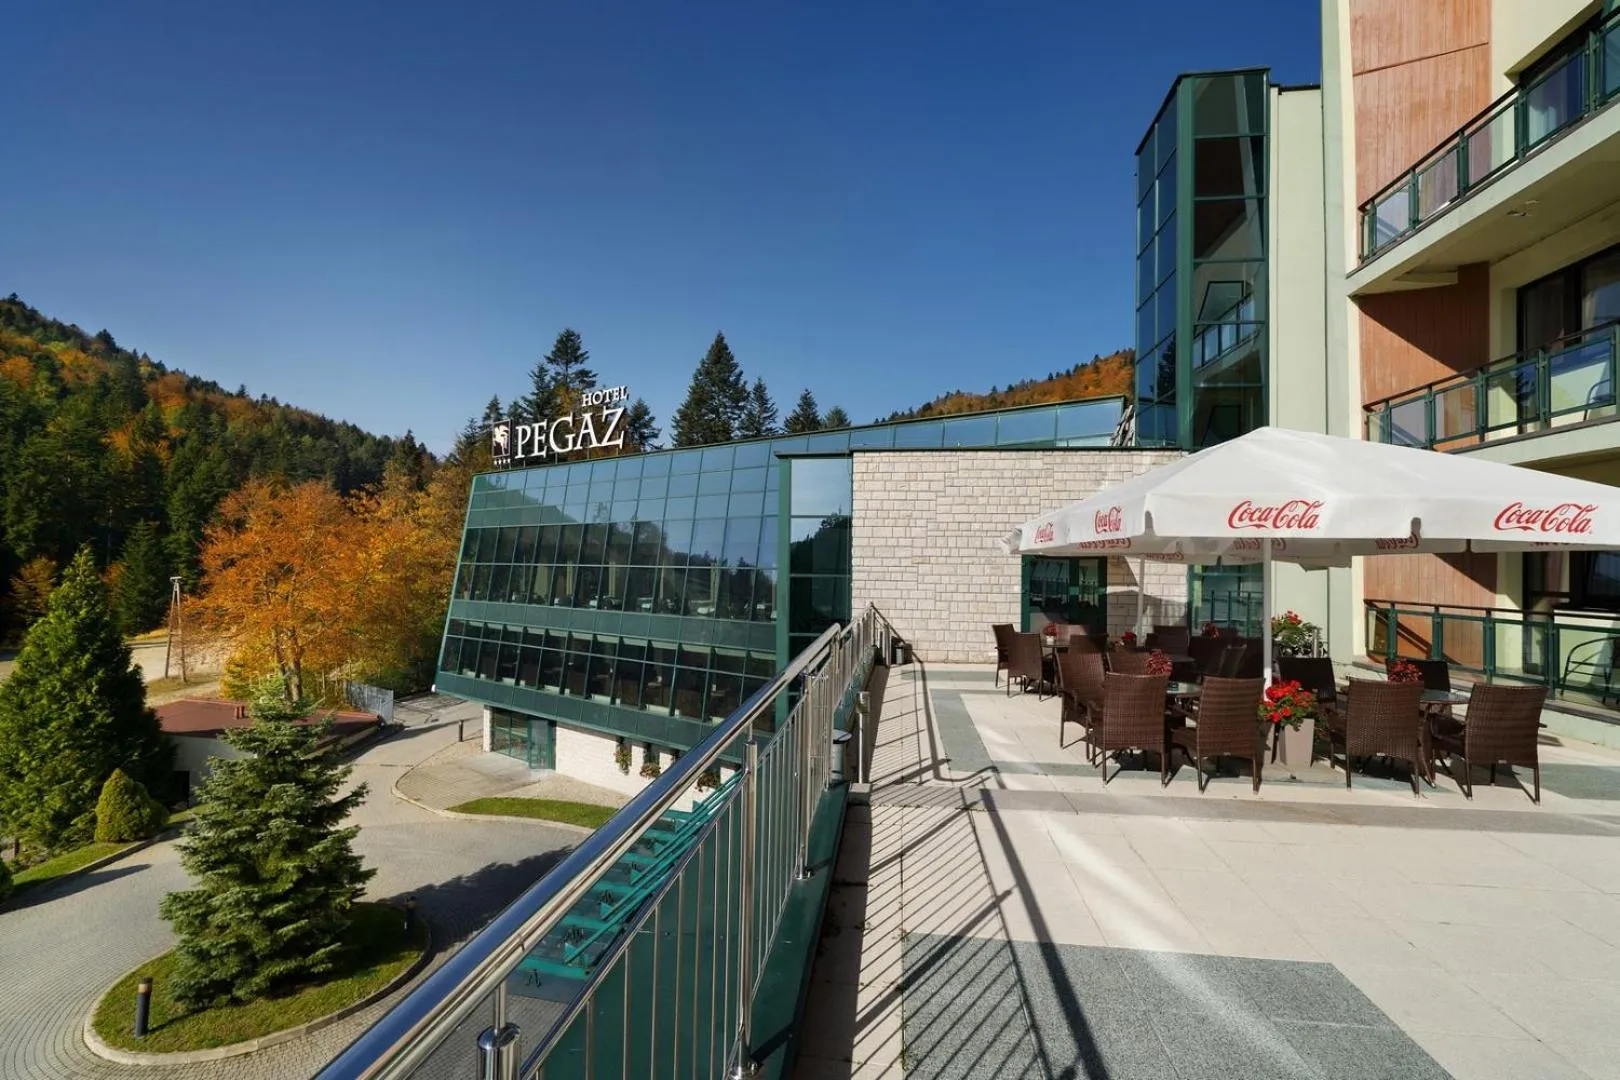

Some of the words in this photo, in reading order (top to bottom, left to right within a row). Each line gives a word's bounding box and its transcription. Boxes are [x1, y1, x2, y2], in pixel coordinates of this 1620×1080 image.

[582, 385, 628, 407] HOTEL
[514, 405, 625, 459] PEGAZ
[1228, 500, 1324, 529] Coca-Cola
[1494, 501, 1598, 534] Coca-Cola
